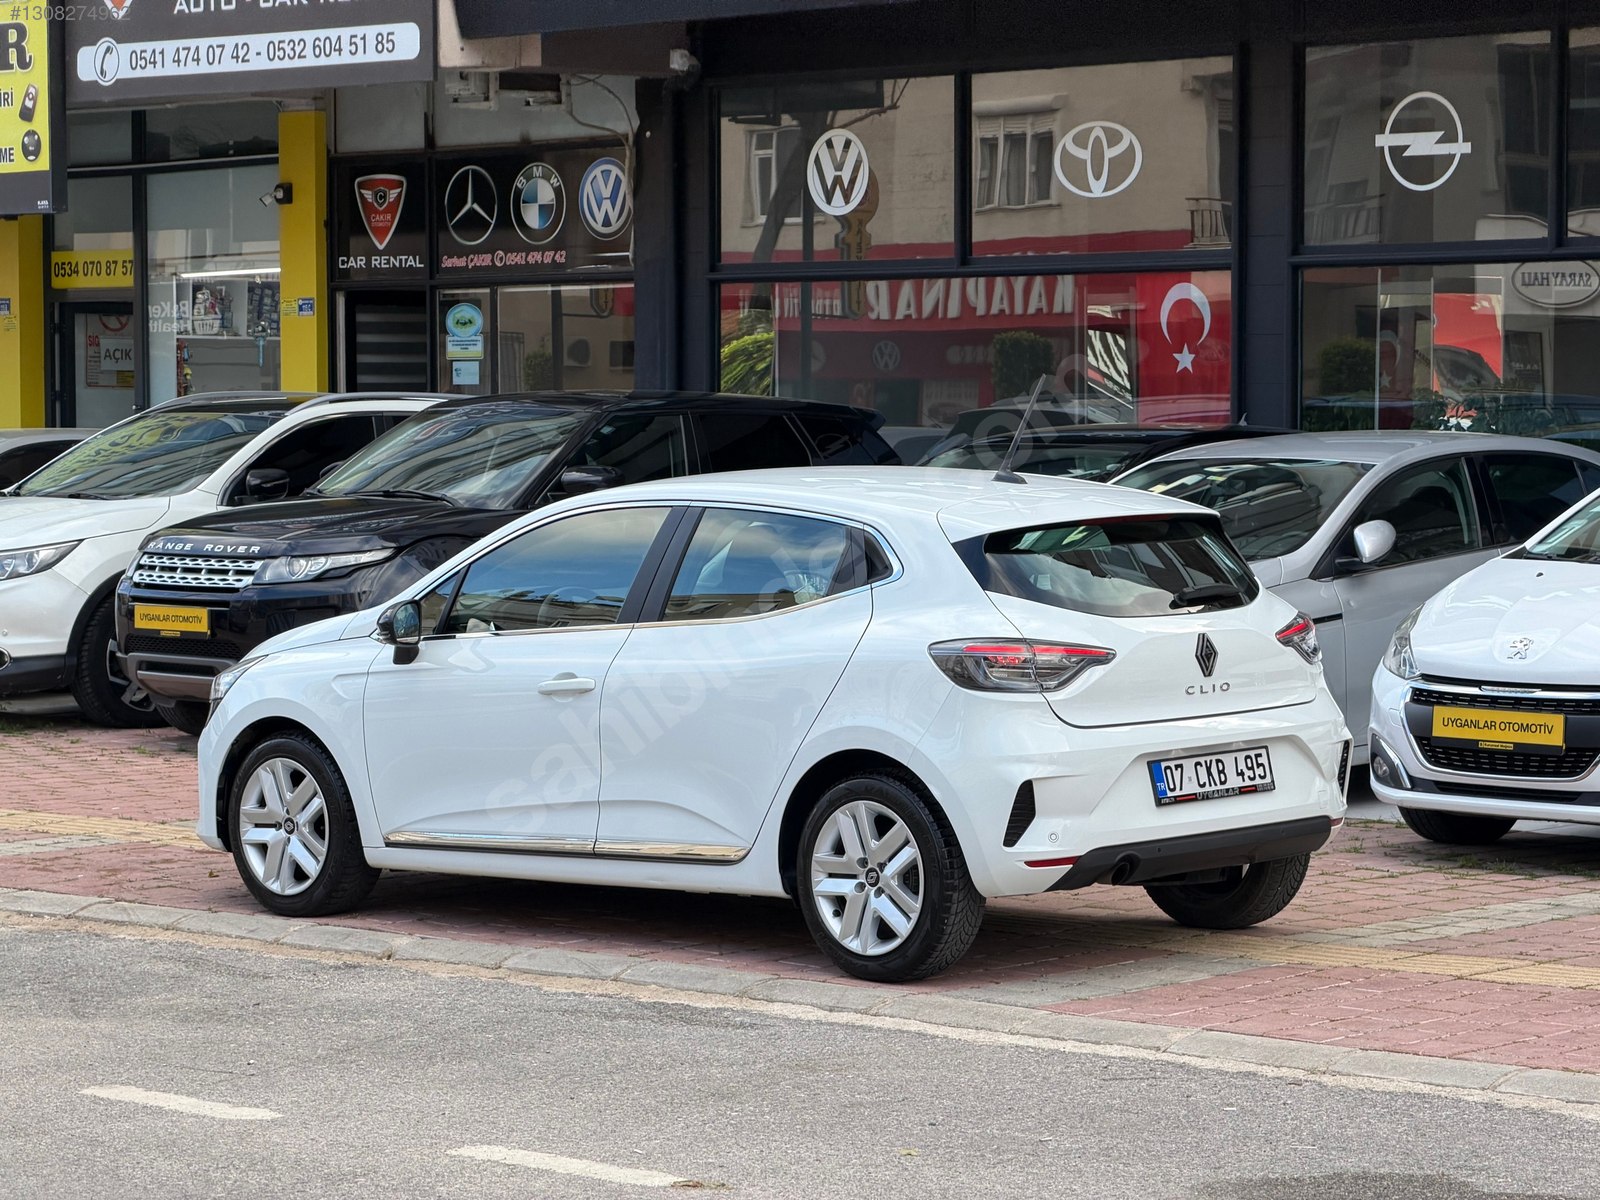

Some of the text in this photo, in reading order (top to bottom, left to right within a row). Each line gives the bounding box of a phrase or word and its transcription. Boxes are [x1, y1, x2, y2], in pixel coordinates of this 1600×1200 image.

[129, 48, 166, 71] 0541
[172, 45, 201, 68] 474
[206, 44, 226, 66] 07
[230, 42, 250, 64] 42
[266, 38, 307, 62] 0532
[312, 35, 343, 58] 604
[348, 33, 368, 56] 51
[375, 32, 396, 54] 85
[516, 166, 560, 189] BMW
[338, 256, 424, 268] CAR RENTAL
[506, 252, 526, 265] 0541
[543, 251, 555, 263] 07
[555, 250, 566, 263] 42
[54, 260, 134, 278] 0534 070 87 57
[103, 348, 132, 363] AÇIK
[147, 542, 261, 554] RANGE ROVER
[140, 613, 202, 624] UYGANLAR OTOMOTİV
[1185, 682, 1230, 695] CLIO
[1442, 717, 1554, 734] UYGANLAR OTOMOTİV
[1156, 752, 1267, 793] TR 07 CKB 495
[1196, 787, 1240, 800] UYGANLAR
